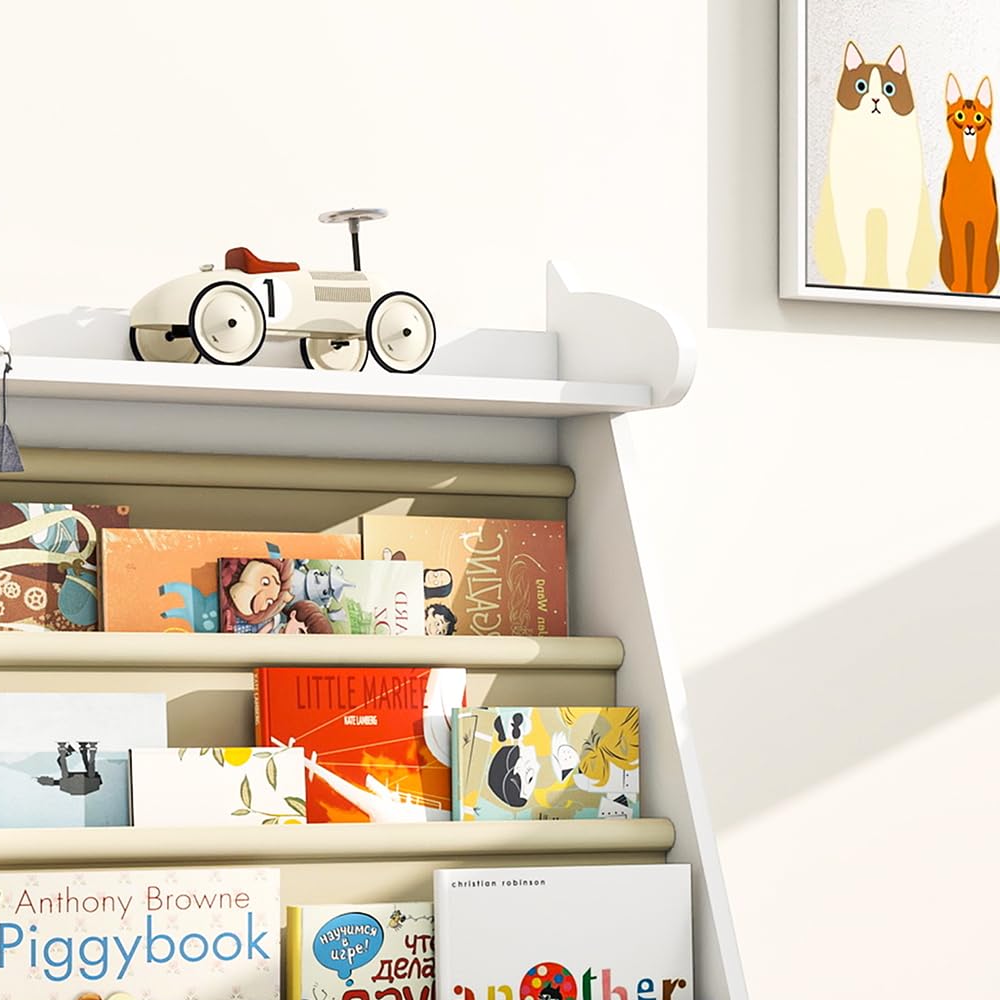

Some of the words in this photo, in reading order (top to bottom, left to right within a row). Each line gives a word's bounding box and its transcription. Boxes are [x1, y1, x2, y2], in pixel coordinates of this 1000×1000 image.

[263, 278, 275, 318] 1
[296, 676, 357, 709] LITTLE
[451, 880, 497, 888] christian
[502, 879, 546, 887] robinson
[14, 886, 133, 919] Anthony
[147, 886, 250, 911] Browne
[320, 924, 378, 945] научимся
[341, 937, 349, 947] в
[330, 939, 369, 965] игре!
